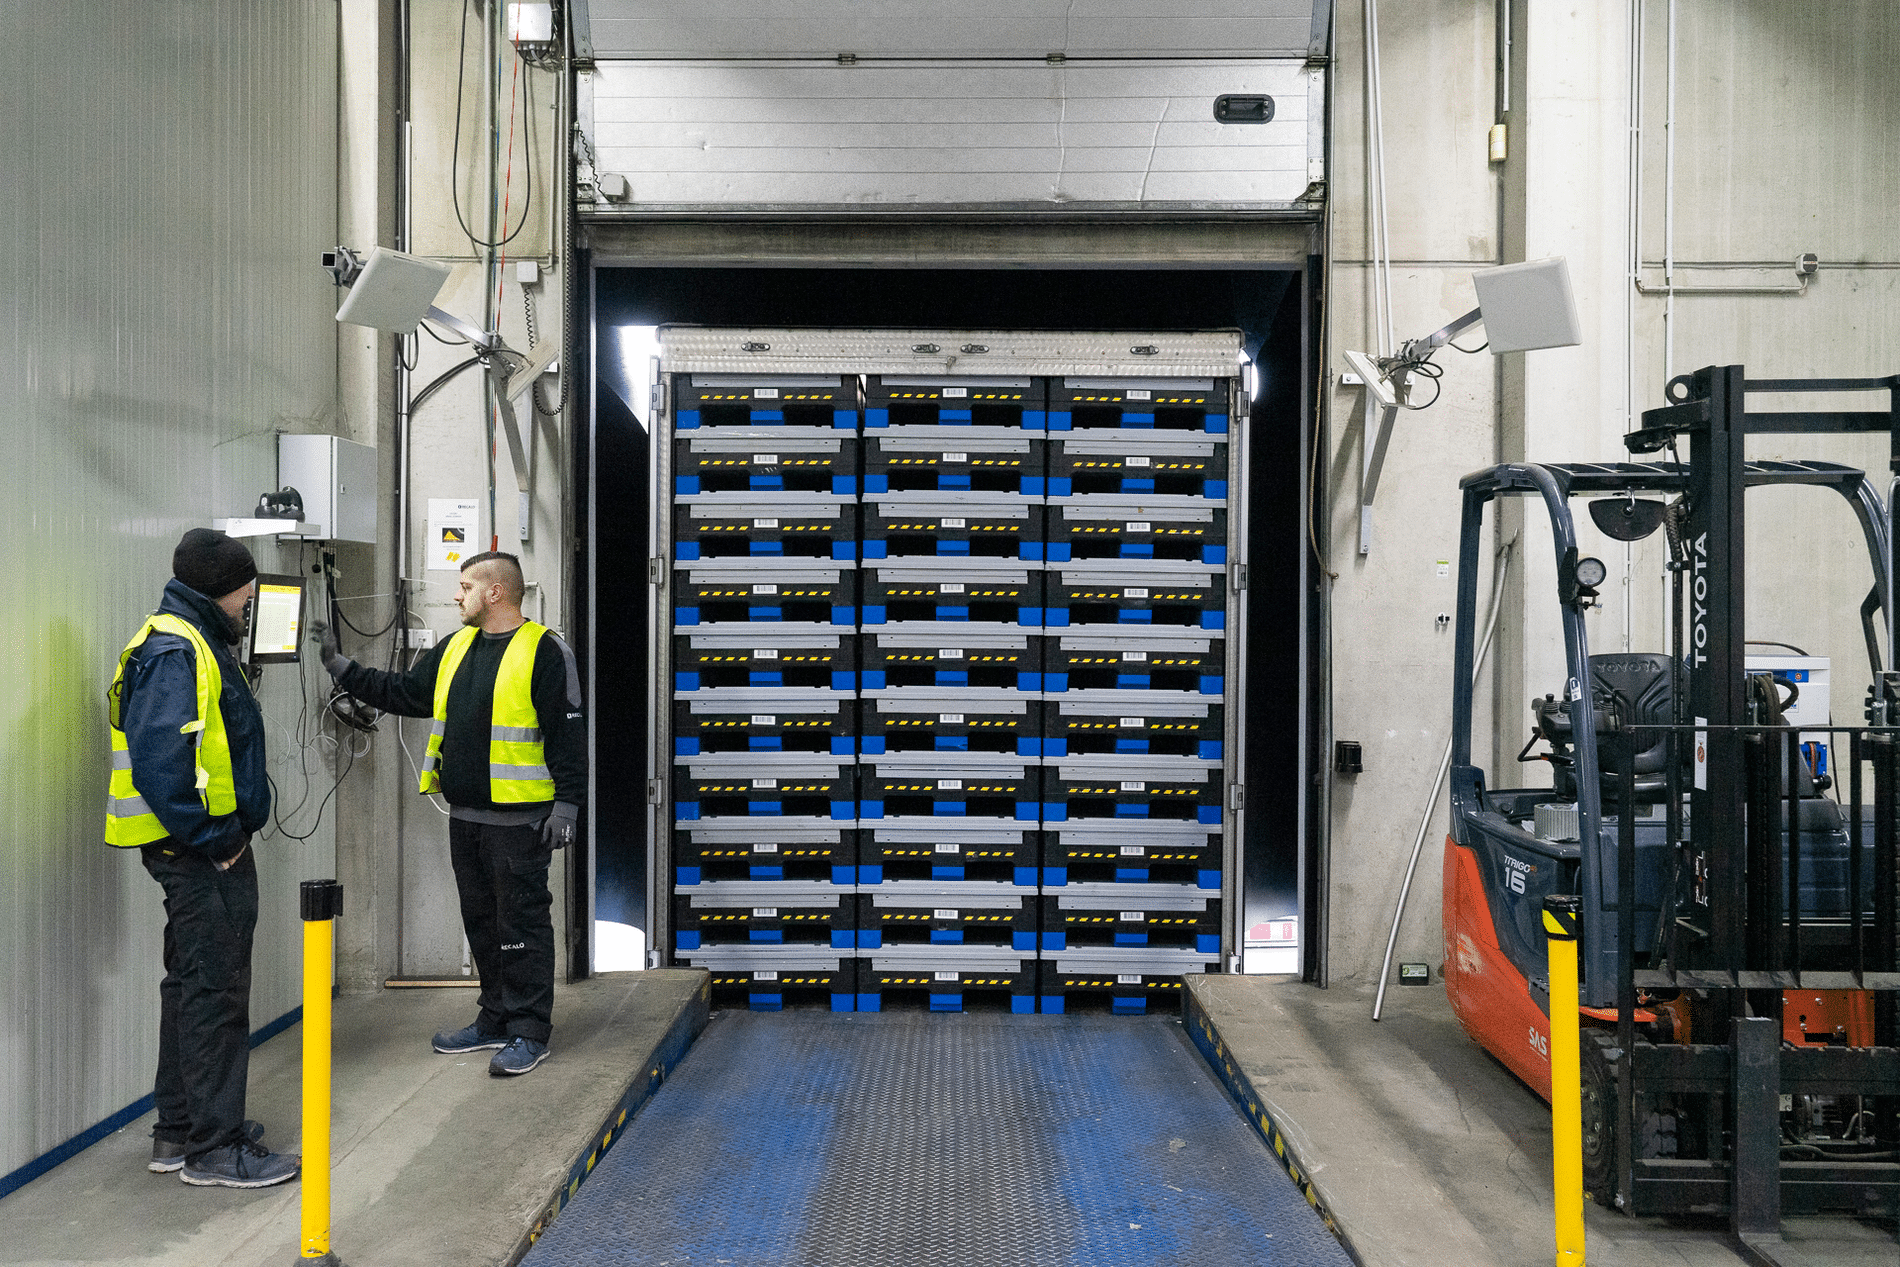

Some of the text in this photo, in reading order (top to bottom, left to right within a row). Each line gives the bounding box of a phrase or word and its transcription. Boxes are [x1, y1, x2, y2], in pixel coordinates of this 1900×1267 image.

[1695, 532, 1707, 669] TOYOTA
[1597, 661, 1661, 673] TOYOTA
[1505, 866, 1526, 895] 16
[1529, 1025, 1547, 1056] SAS
